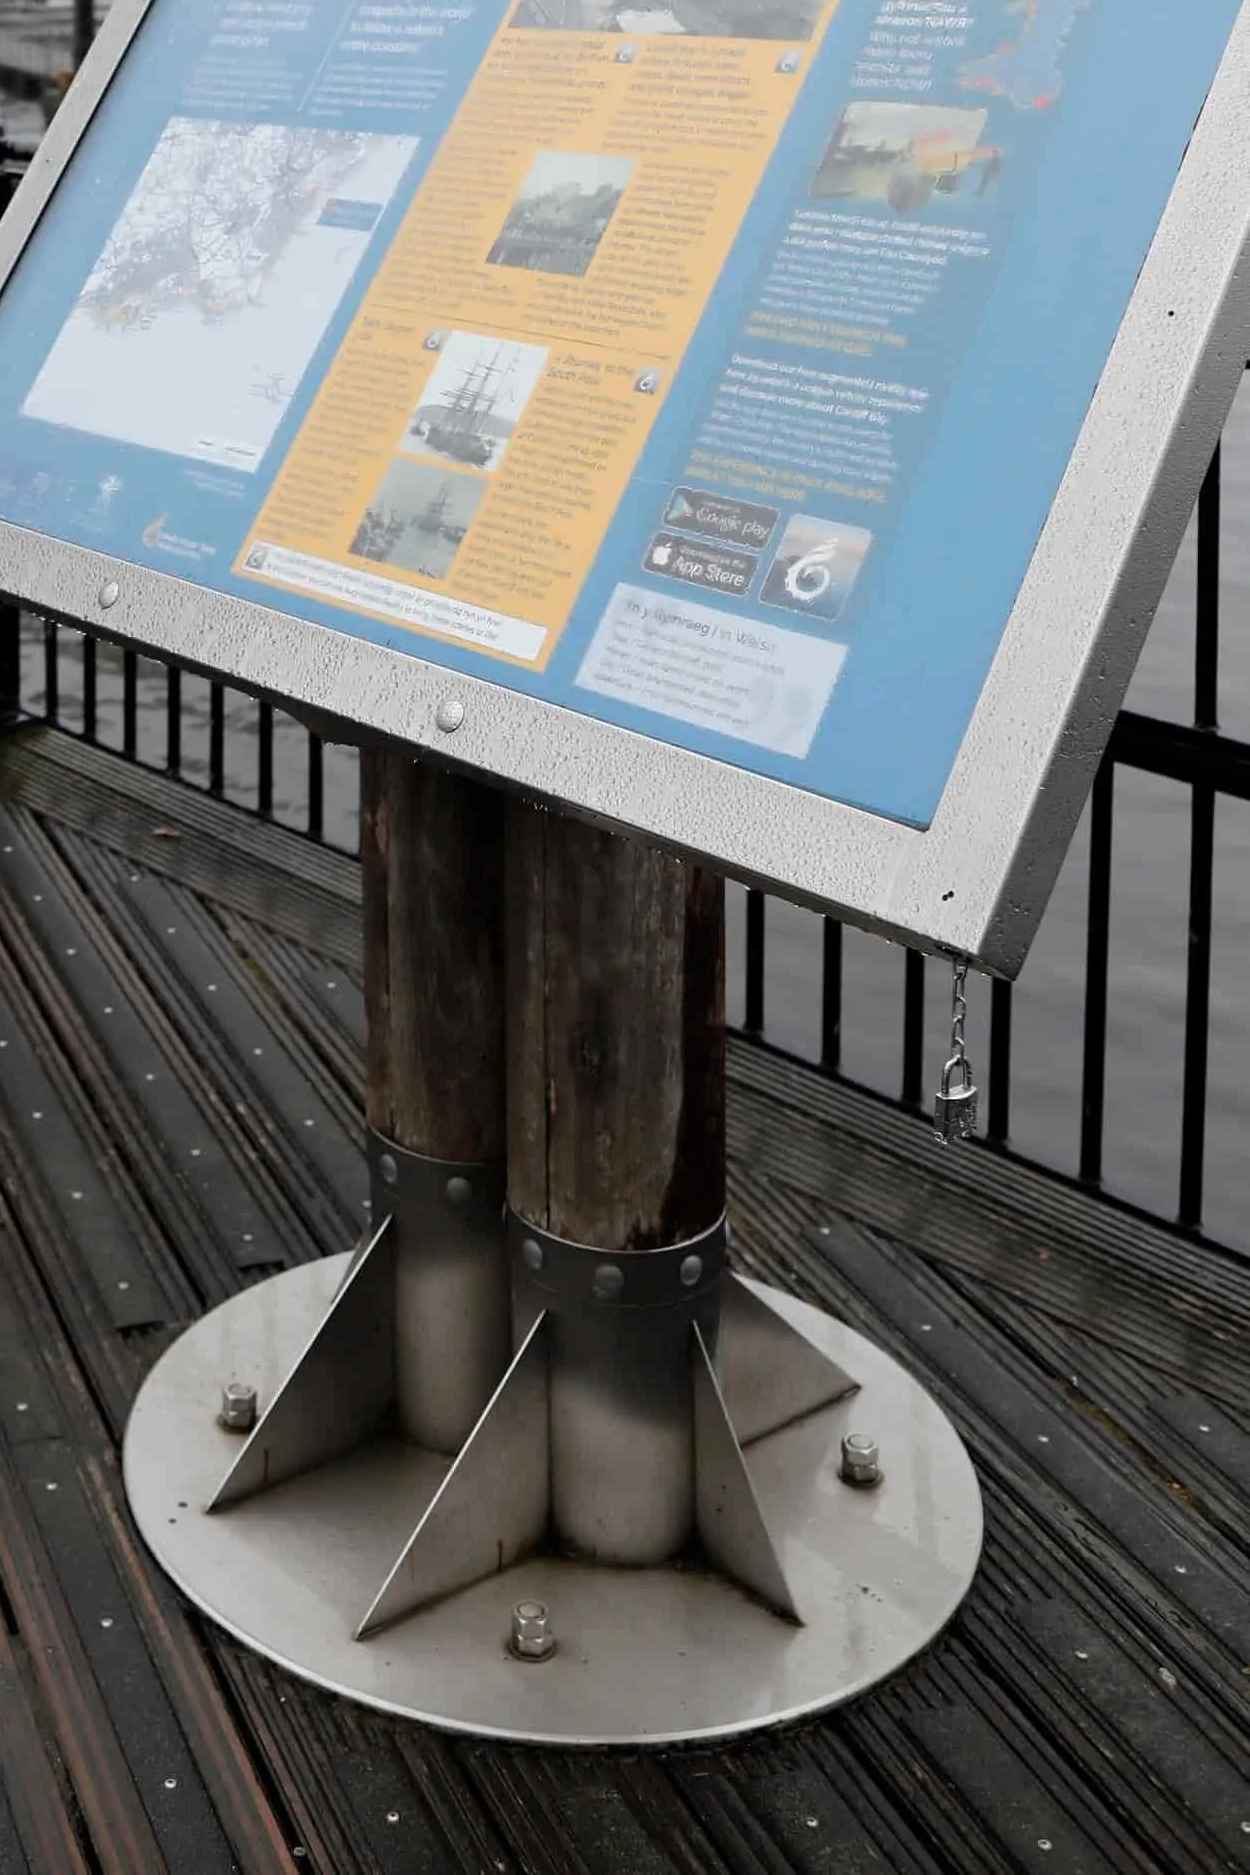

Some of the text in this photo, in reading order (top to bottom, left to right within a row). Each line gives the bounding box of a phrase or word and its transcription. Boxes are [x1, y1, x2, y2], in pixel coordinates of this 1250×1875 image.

[415, 8, 438, 20] the
[803, 399, 834, 415] about
[692, 505, 744, 535] Google
[739, 516, 772, 541] play
[670, 555, 748, 589] App Store
